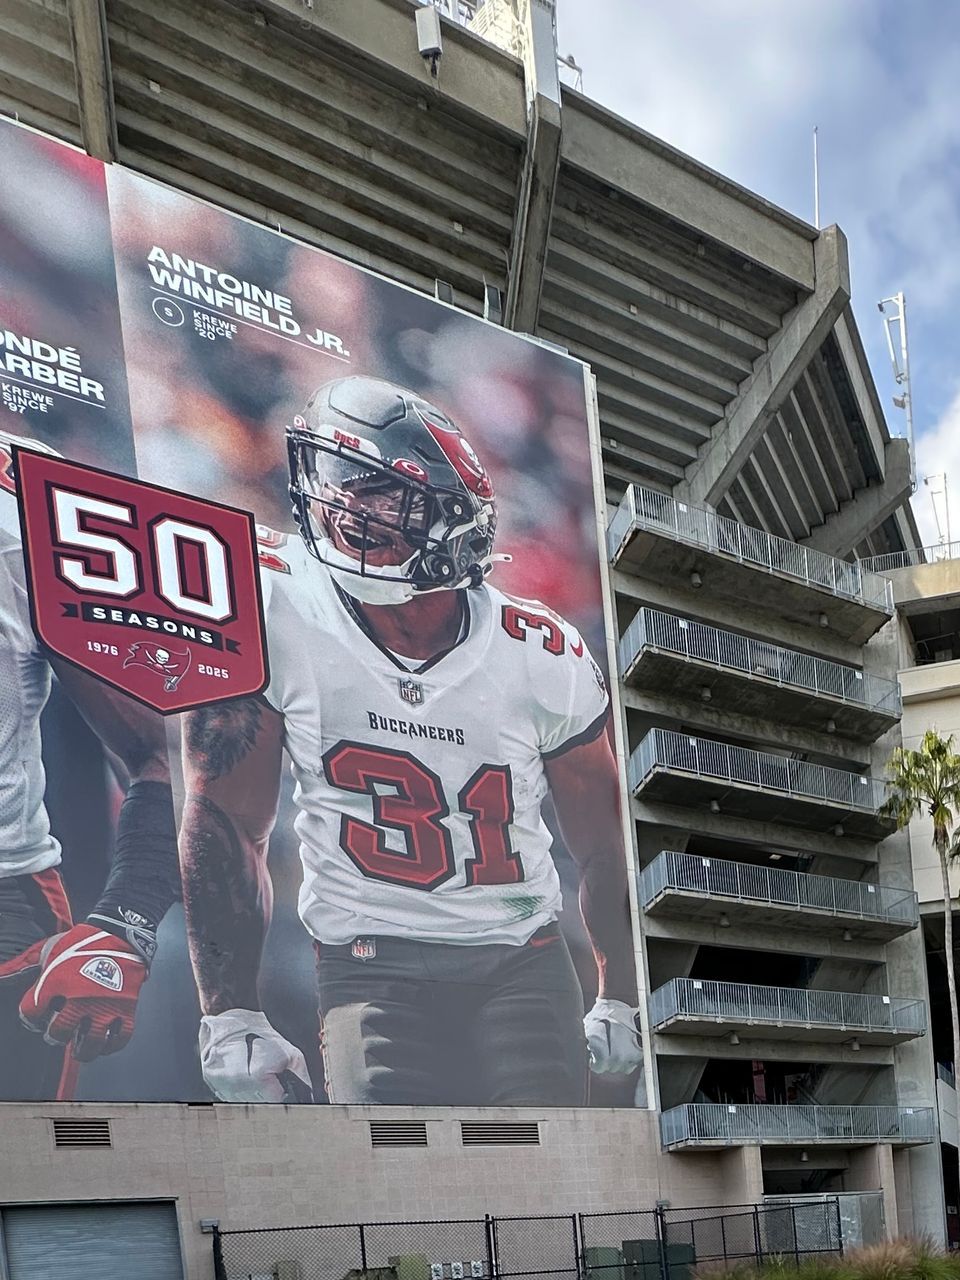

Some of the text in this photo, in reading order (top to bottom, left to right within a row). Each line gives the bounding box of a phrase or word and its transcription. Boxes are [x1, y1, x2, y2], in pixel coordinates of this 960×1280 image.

[148, 245, 293, 316] ANTOINE
[148, 263, 351, 357] WINFIELD JR.
[164, 306, 174, 318] S
[193, 309, 238, 334] KREWE
[193, 318, 233, 340] SINCE
[0, 330, 82, 373] NDÉ
[0, 352, 105, 401] RBER
[2, 382, 54, 406] KREWE
[3, 391, 48, 413] SINCE
[47, 483, 235, 624] 50
[92, 607, 214, 645] SEASONS
[87, 641, 119, 656] 1976
[198, 663, 229, 679] 2025
[367, 710, 465, 746] BUCCANEERS
[321, 739, 525, 892] 31
